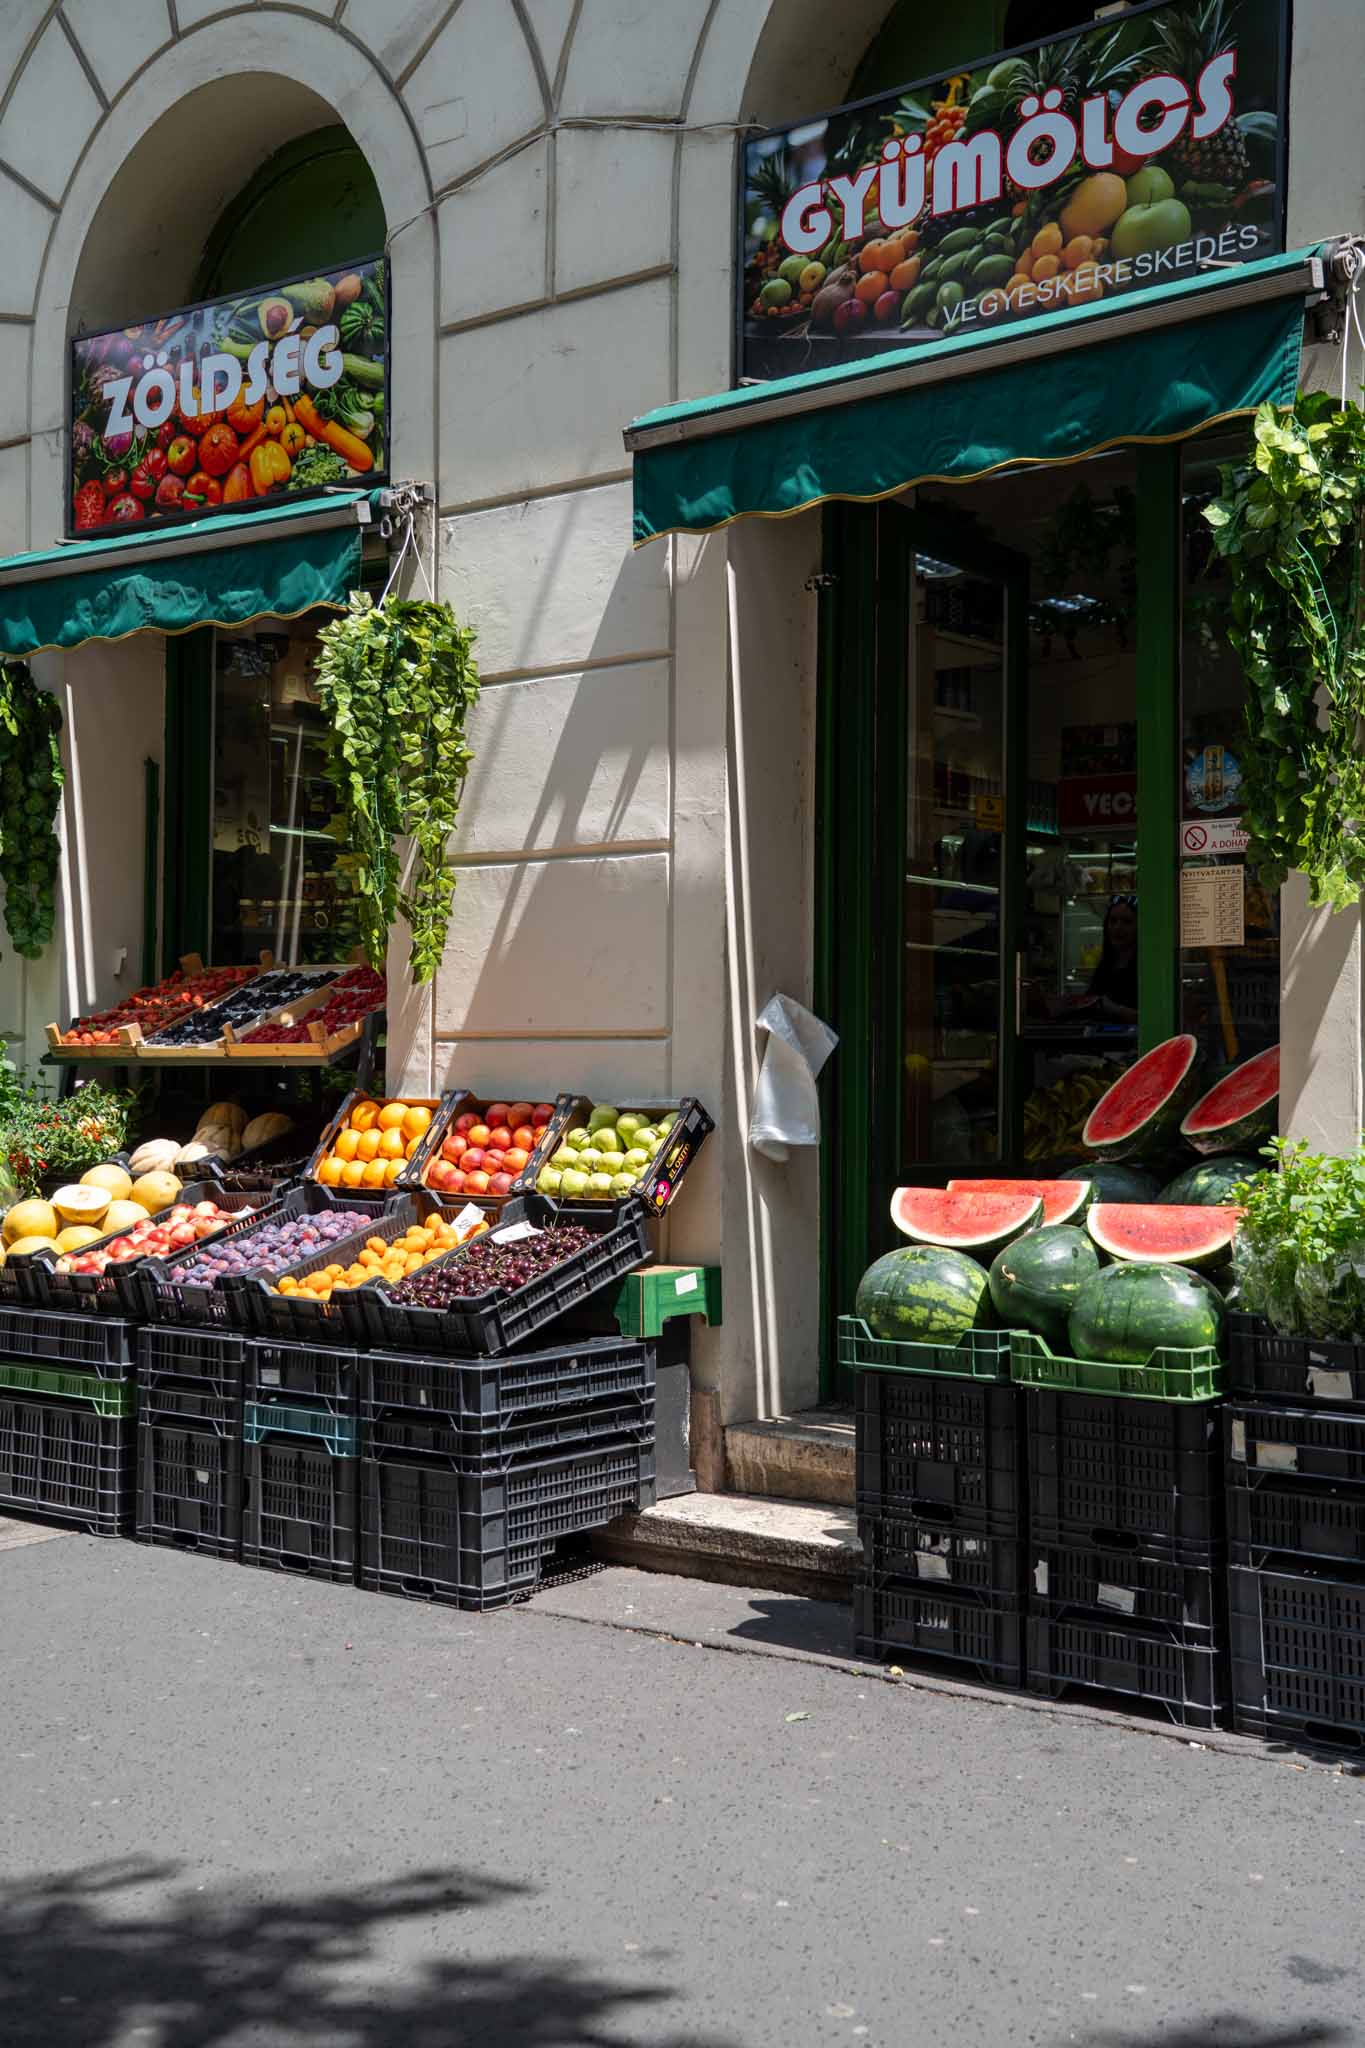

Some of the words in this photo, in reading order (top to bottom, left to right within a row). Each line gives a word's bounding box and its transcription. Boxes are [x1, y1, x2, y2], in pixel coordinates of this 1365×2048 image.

[782, 51, 1237, 253] GYÜMÖLCS
[942, 224, 1258, 326] VEGYESKERESKEDÉS
[103, 317, 343, 438] ZÖLDSÉG
